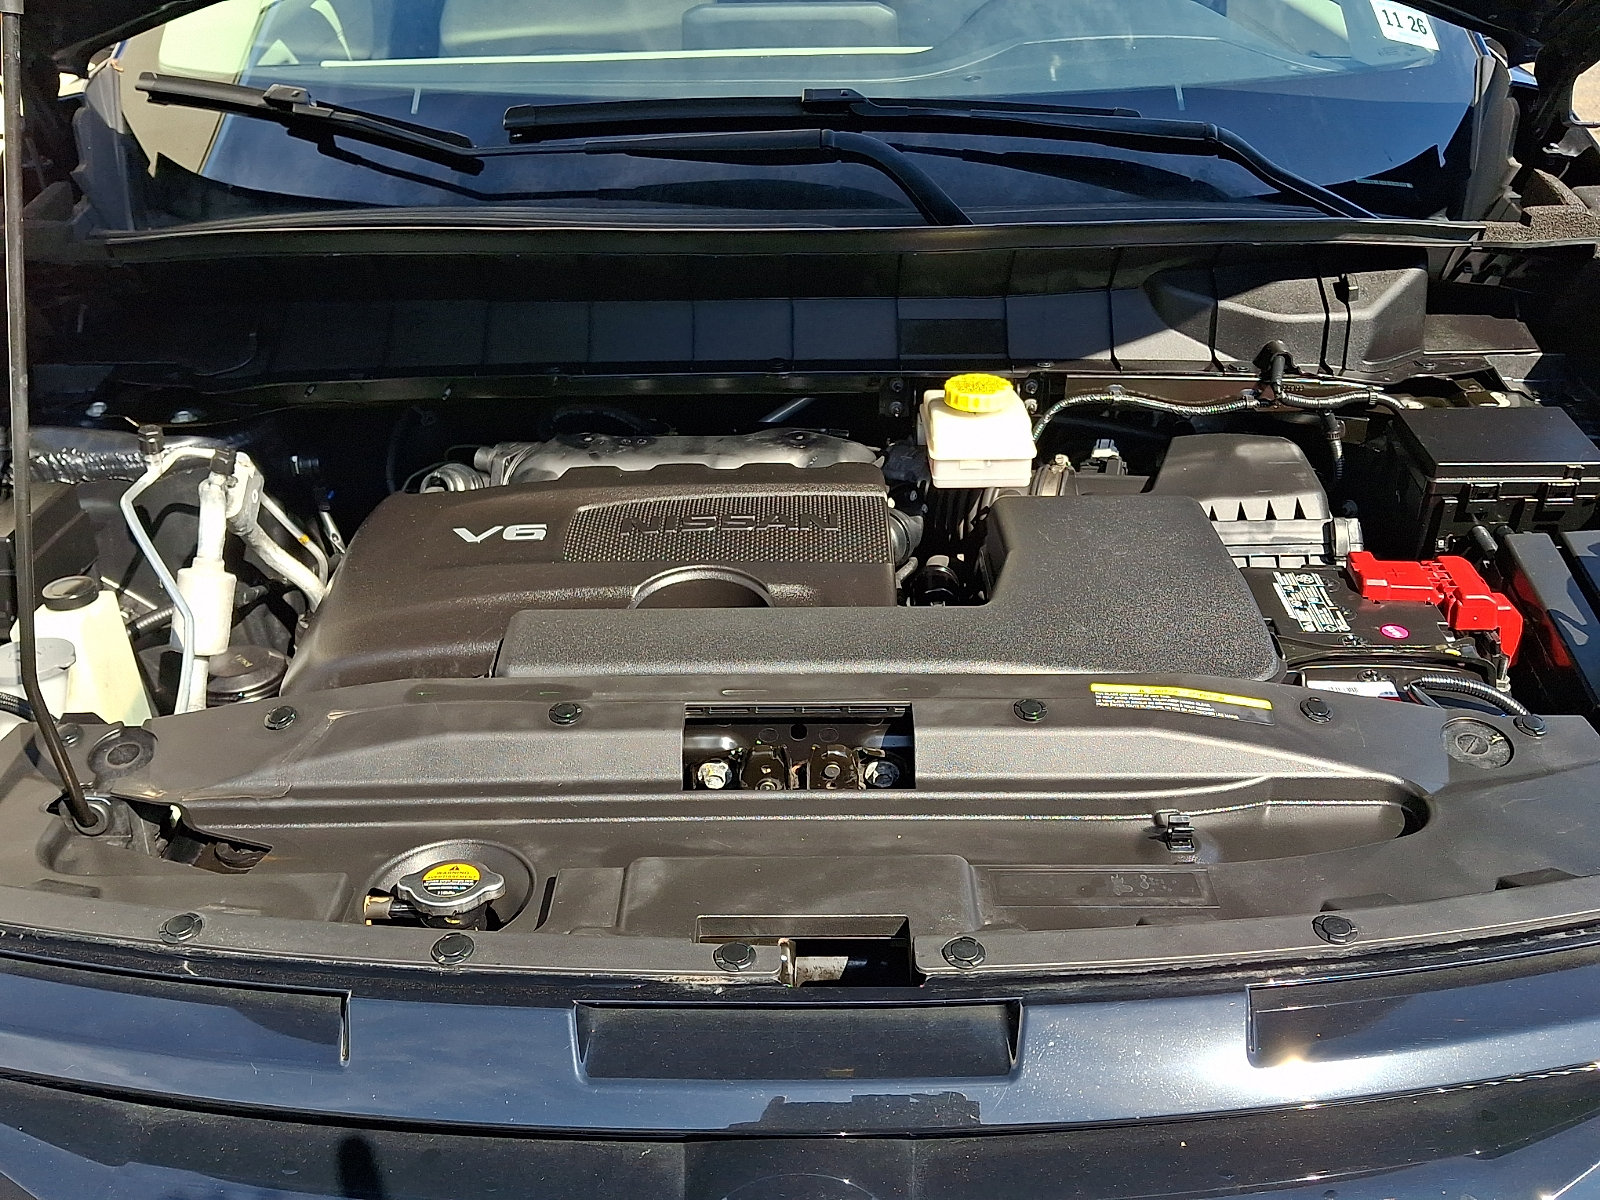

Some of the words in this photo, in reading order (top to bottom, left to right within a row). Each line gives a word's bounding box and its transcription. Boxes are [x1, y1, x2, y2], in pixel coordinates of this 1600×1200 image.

[1382, 9, 1404, 28] 11
[1407, 15, 1427, 35] 26
[452, 523, 548, 544] V6
[620, 512, 839, 536] NISSAN
